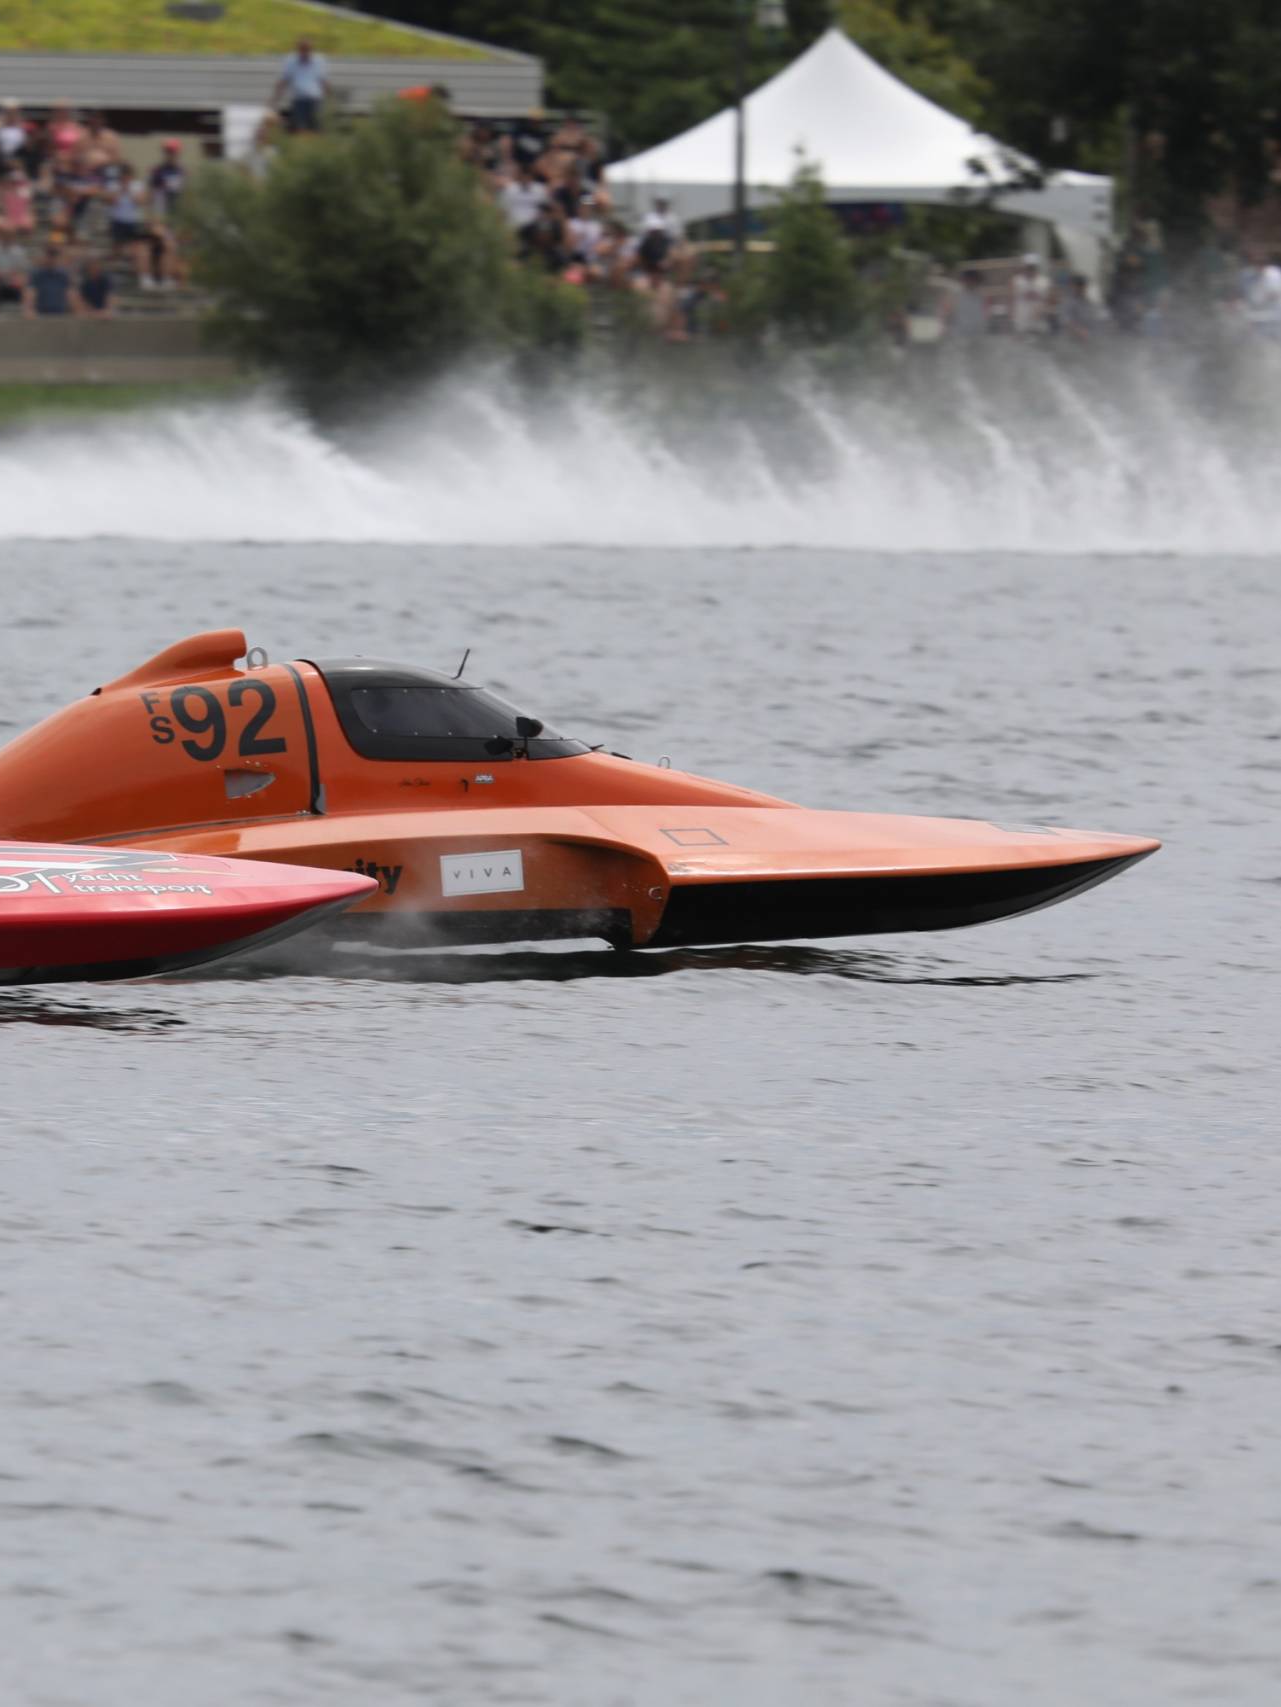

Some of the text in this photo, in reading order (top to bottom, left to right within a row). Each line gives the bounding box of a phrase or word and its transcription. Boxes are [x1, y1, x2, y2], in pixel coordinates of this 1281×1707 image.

[171, 679, 288, 762] 92
[62, 872, 144, 883] yacht
[342, 858, 404, 896] ity
[453, 866, 512, 879] VIVA
[73, 883, 213, 896] transport
